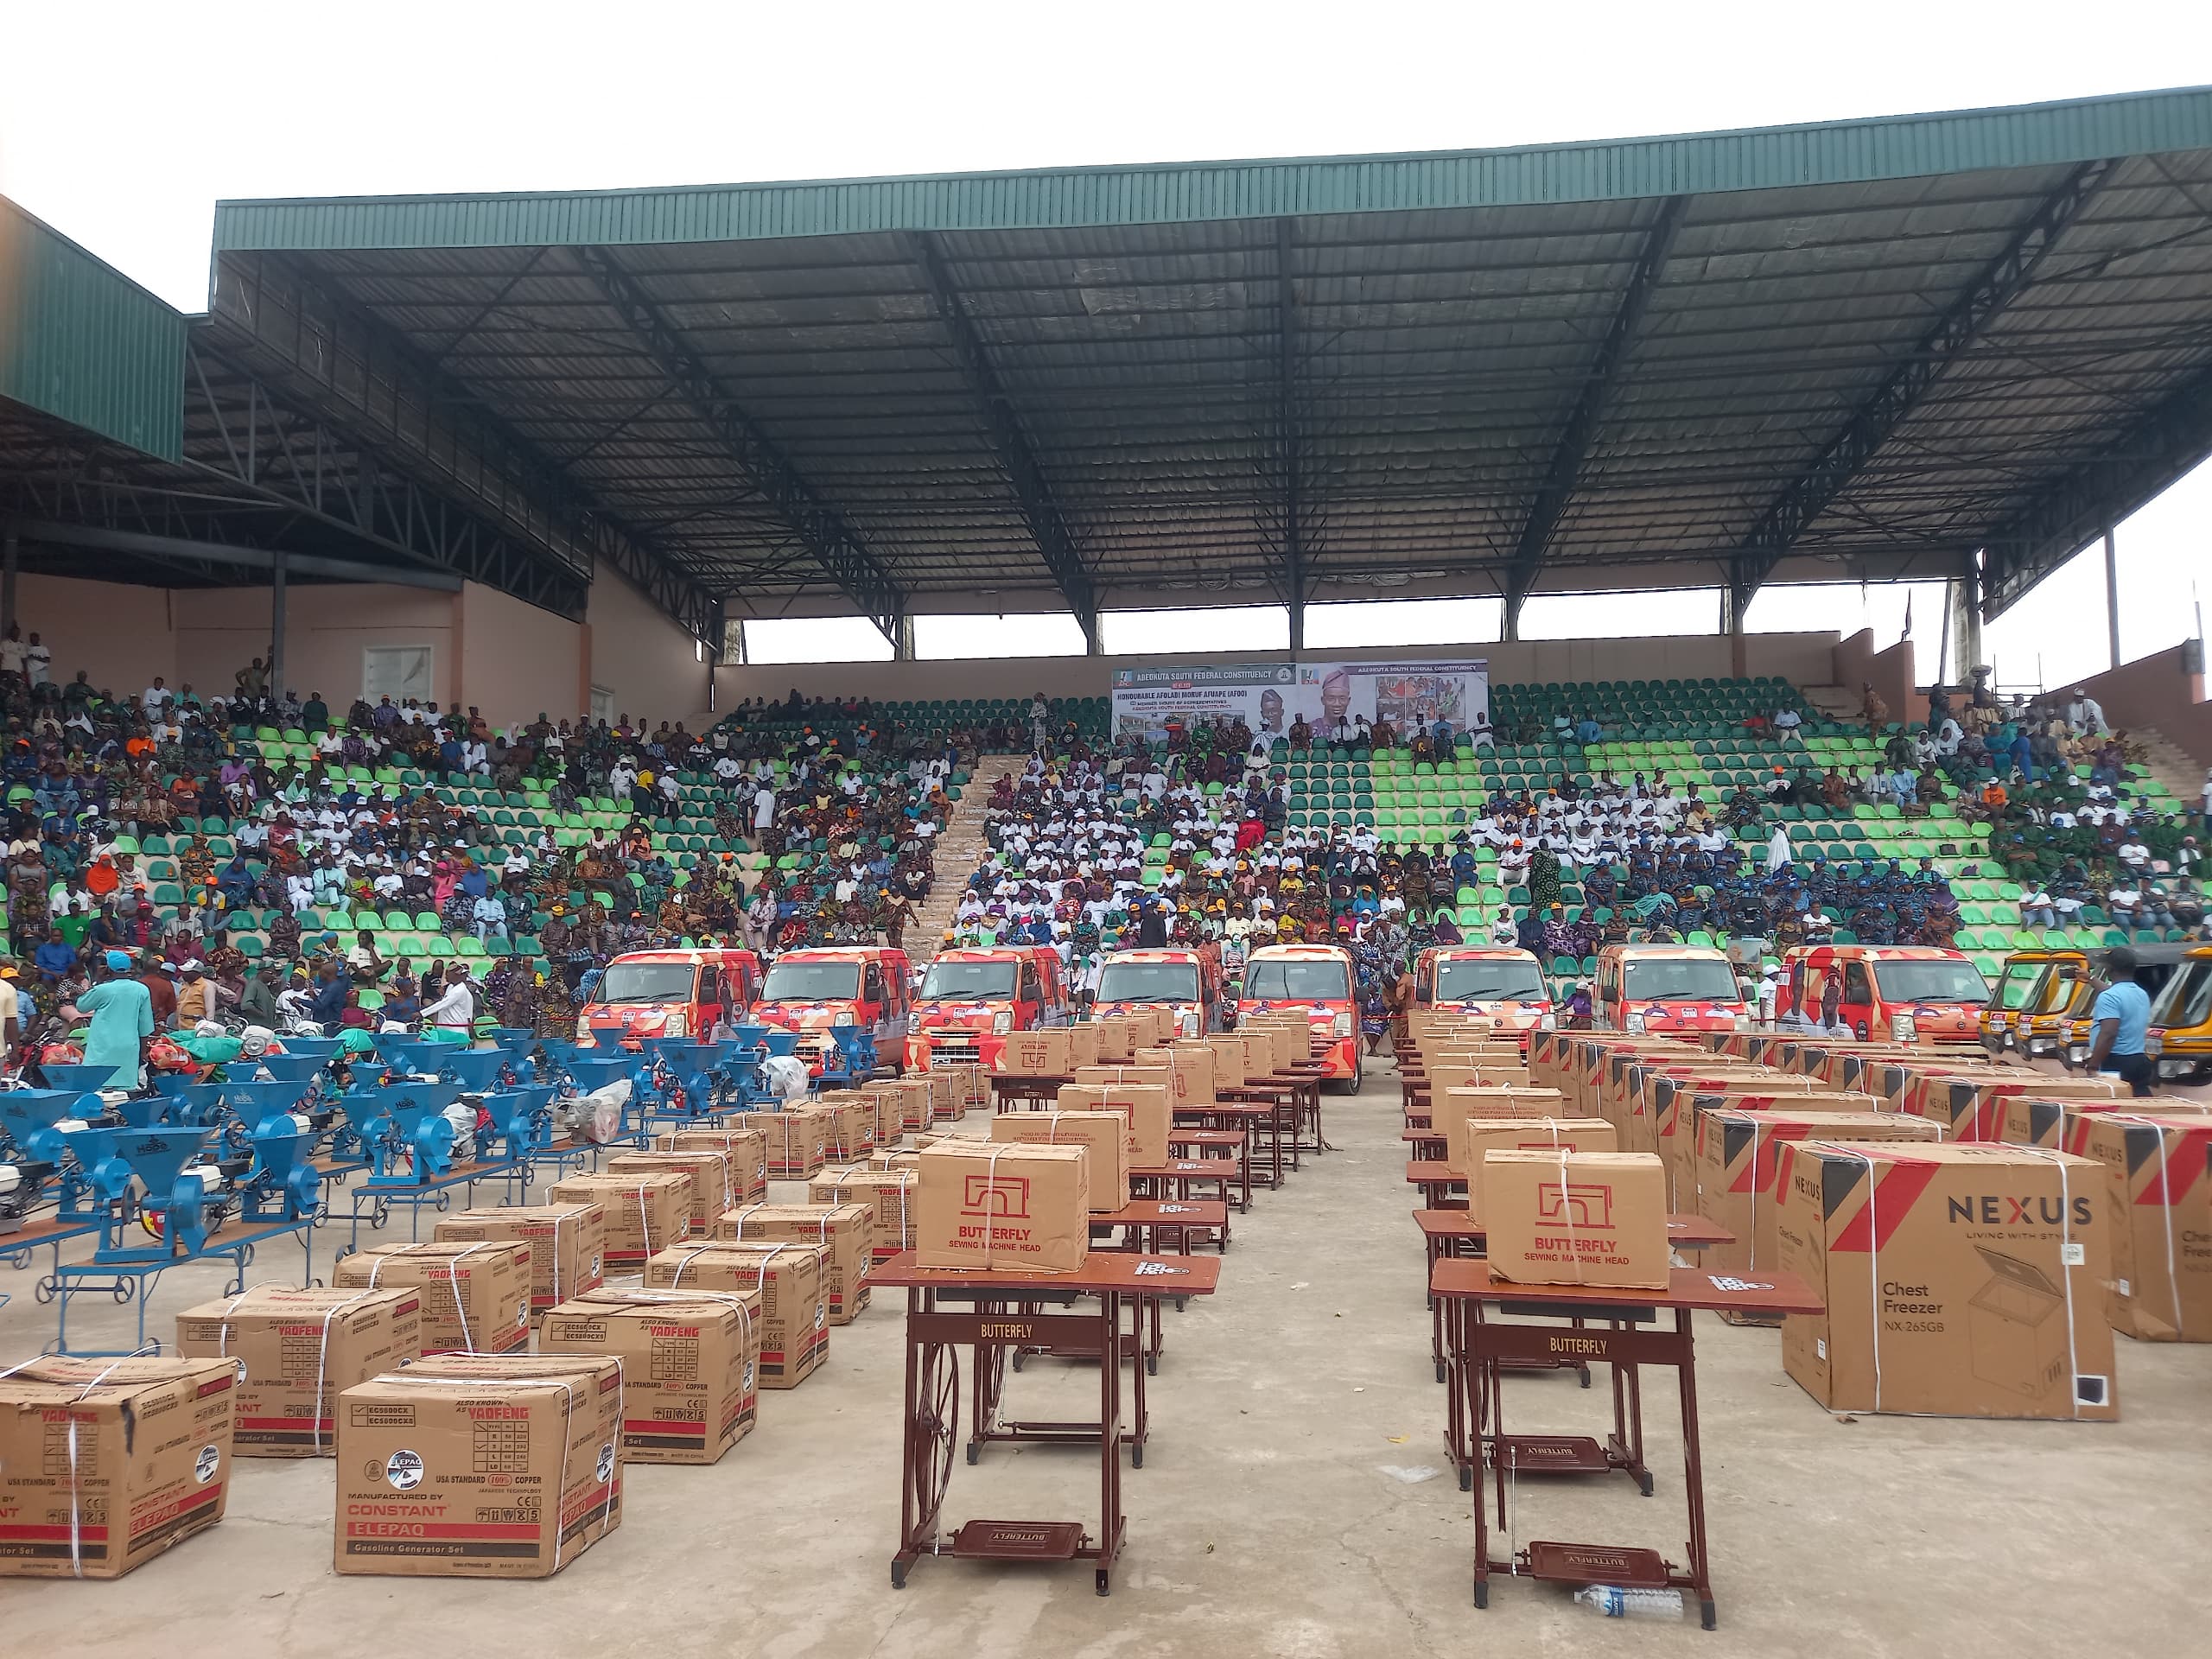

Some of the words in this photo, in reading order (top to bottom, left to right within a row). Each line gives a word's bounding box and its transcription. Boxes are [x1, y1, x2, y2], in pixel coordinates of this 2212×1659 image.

[1136, 672, 1170, 682] ABEOKUTA
[1171, 672, 1192, 681] SOUTH
[1193, 671, 1223, 680] FEDERAL
[1224, 670, 1272, 679] CONSTITUENCY
[2092, 1142, 2123, 1162] NEXUS
[1795, 1175, 1820, 1201] NEXUS
[1948, 1196, 2092, 1225] NEXUS
[2182, 1230, 2212, 1243] Che
[1535, 1236, 1617, 1252] BUTTERFLY
[1524, 1253, 1559, 1262] SEWING
[1561, 1254, 1601, 1264] MAHINE
[1605, 1256, 1630, 1265] HEAD
[734, 1272, 777, 1281] YAOFNG
[1883, 1281, 1929, 1297] Chest
[1884, 1300, 1943, 1314] Freezer
[650, 1326, 699, 1338] YAOFENG
[981, 1323, 1033, 1338] BUTTERFLY
[1885, 1321, 1944, 1332] NX-265GB
[1550, 1337, 1607, 1355] BUTTERFLY
[468, 1407, 530, 1420] YAOFENG
[435, 1475, 450, 1484] USA
[451, 1475, 485, 1484] STANDARD
[515, 1476, 542, 1484] COPPER
[347, 1503, 448, 1517] CONSTANT
[355, 1522, 426, 1537] ELEPAQ
[992, 1533, 1046, 1541] BUTTERFLY
[19, 1547, 35, 1555] Set
[354, 1543, 396, 1554] Gasoline
[397, 1544, 446, 1554] Generator
[448, 1545, 465, 1554] Set
[1568, 1555, 1626, 1567] BUTTERFLY
